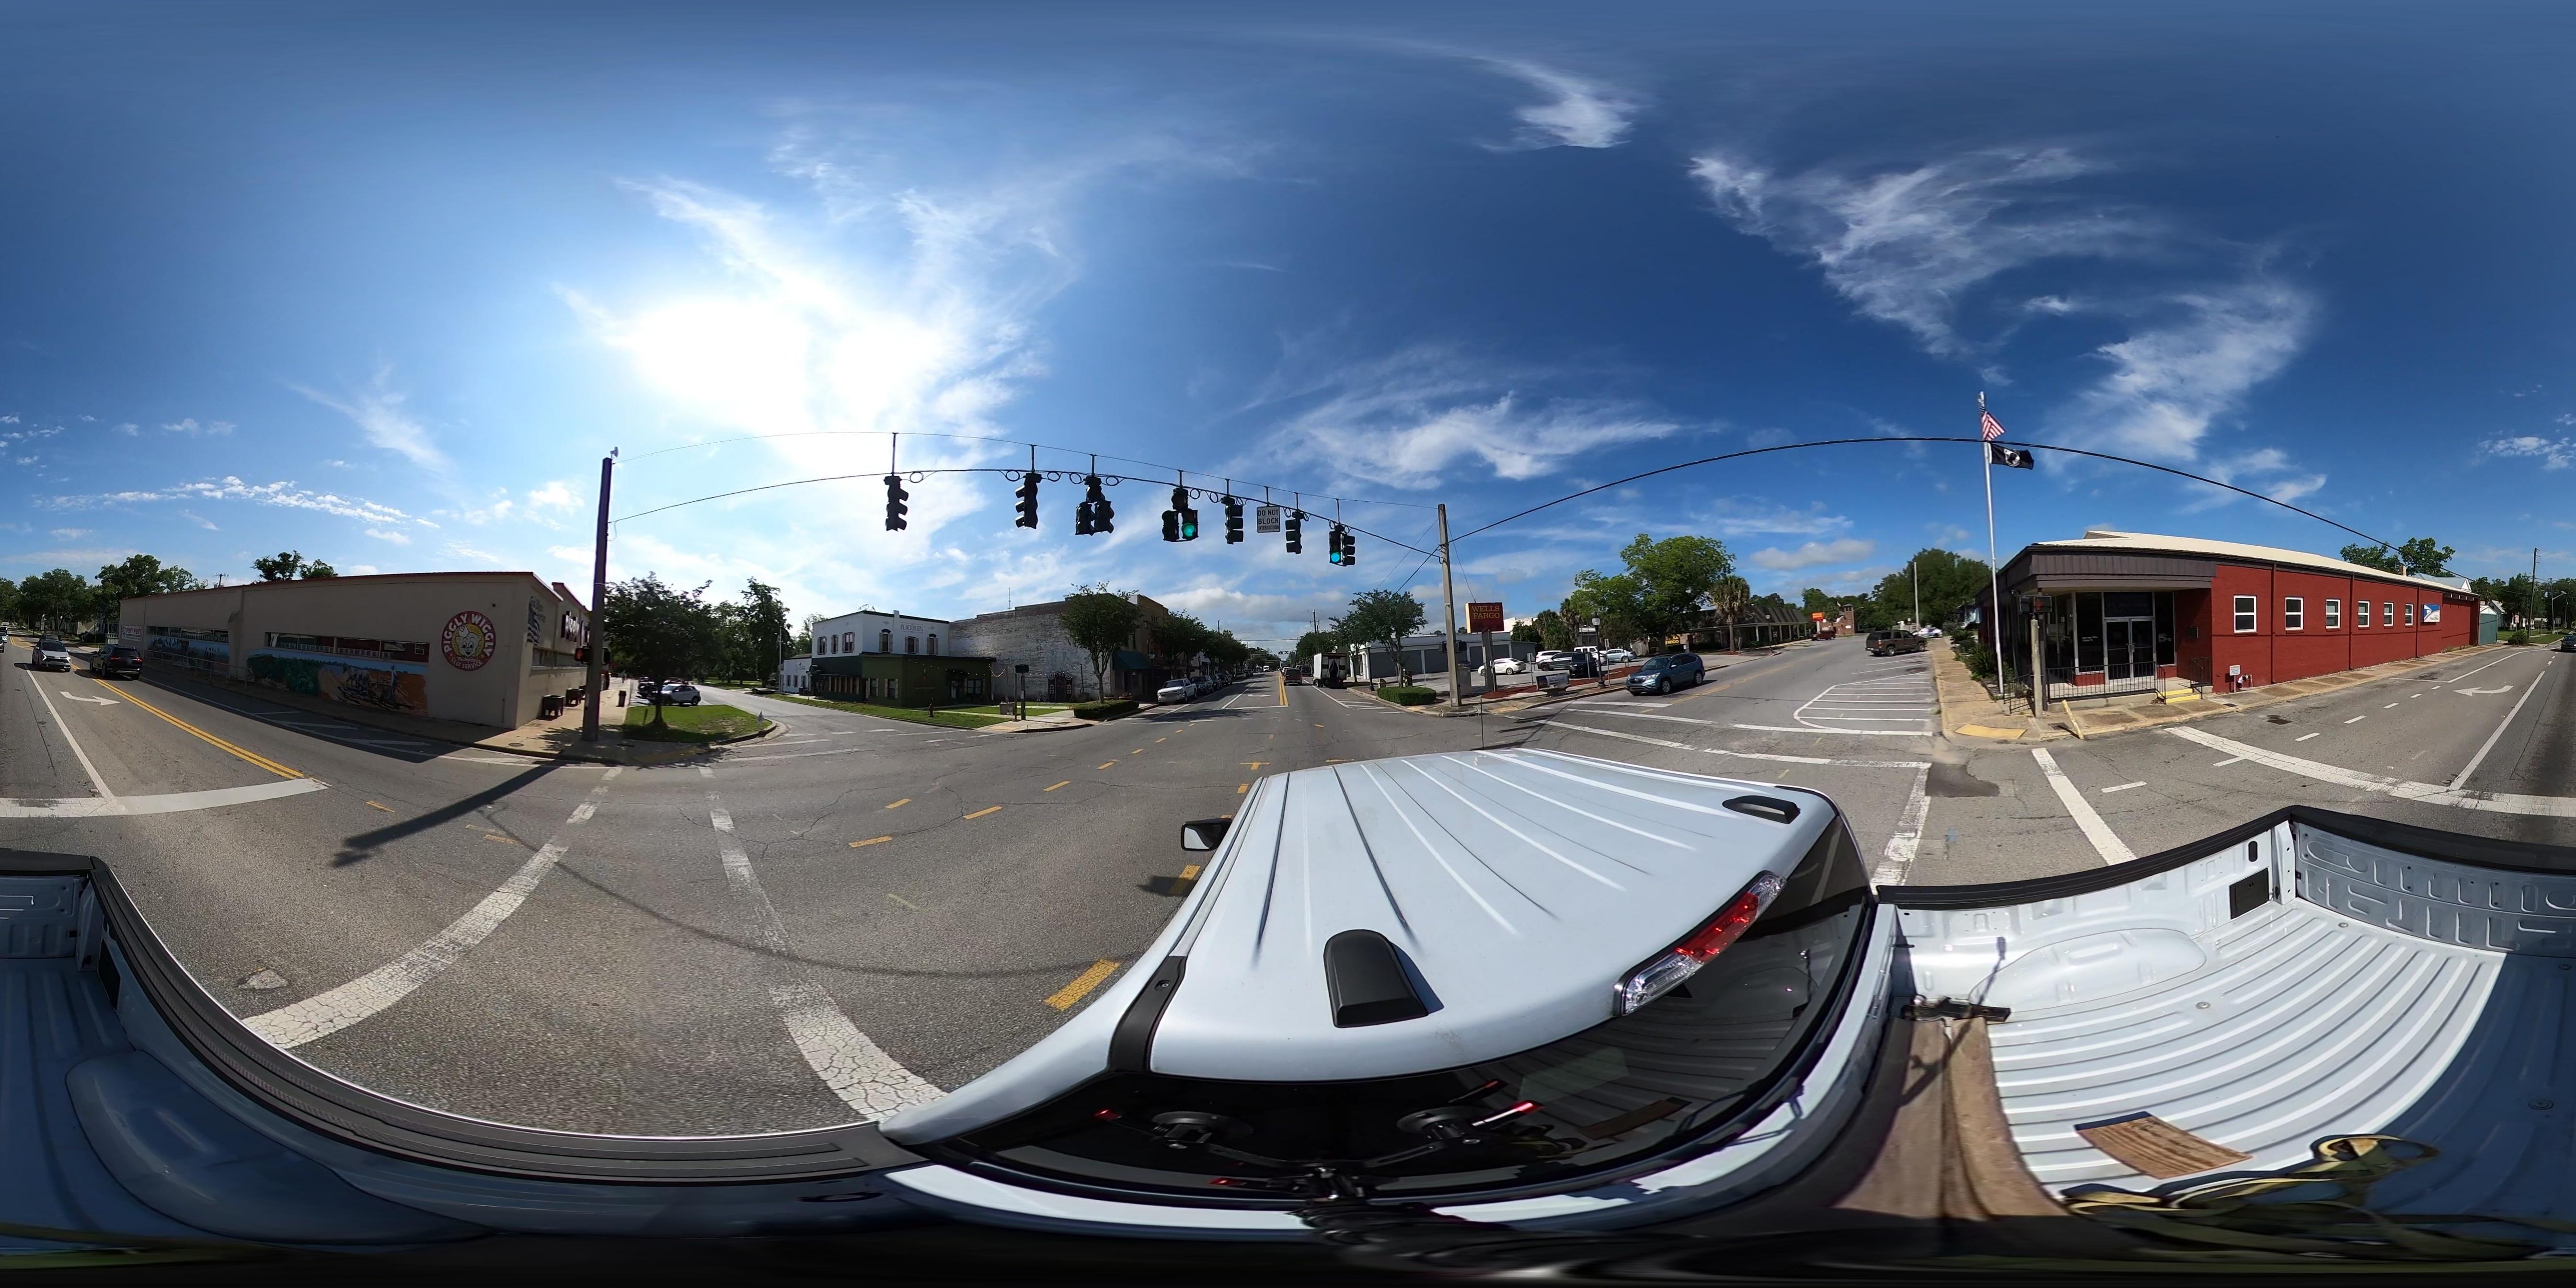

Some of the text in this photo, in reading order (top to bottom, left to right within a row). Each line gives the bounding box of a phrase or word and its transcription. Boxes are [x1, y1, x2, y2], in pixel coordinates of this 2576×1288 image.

[443, 613, 494, 657] PIGGLY WIGGLY
[461, 659, 483, 669] SERVICE
